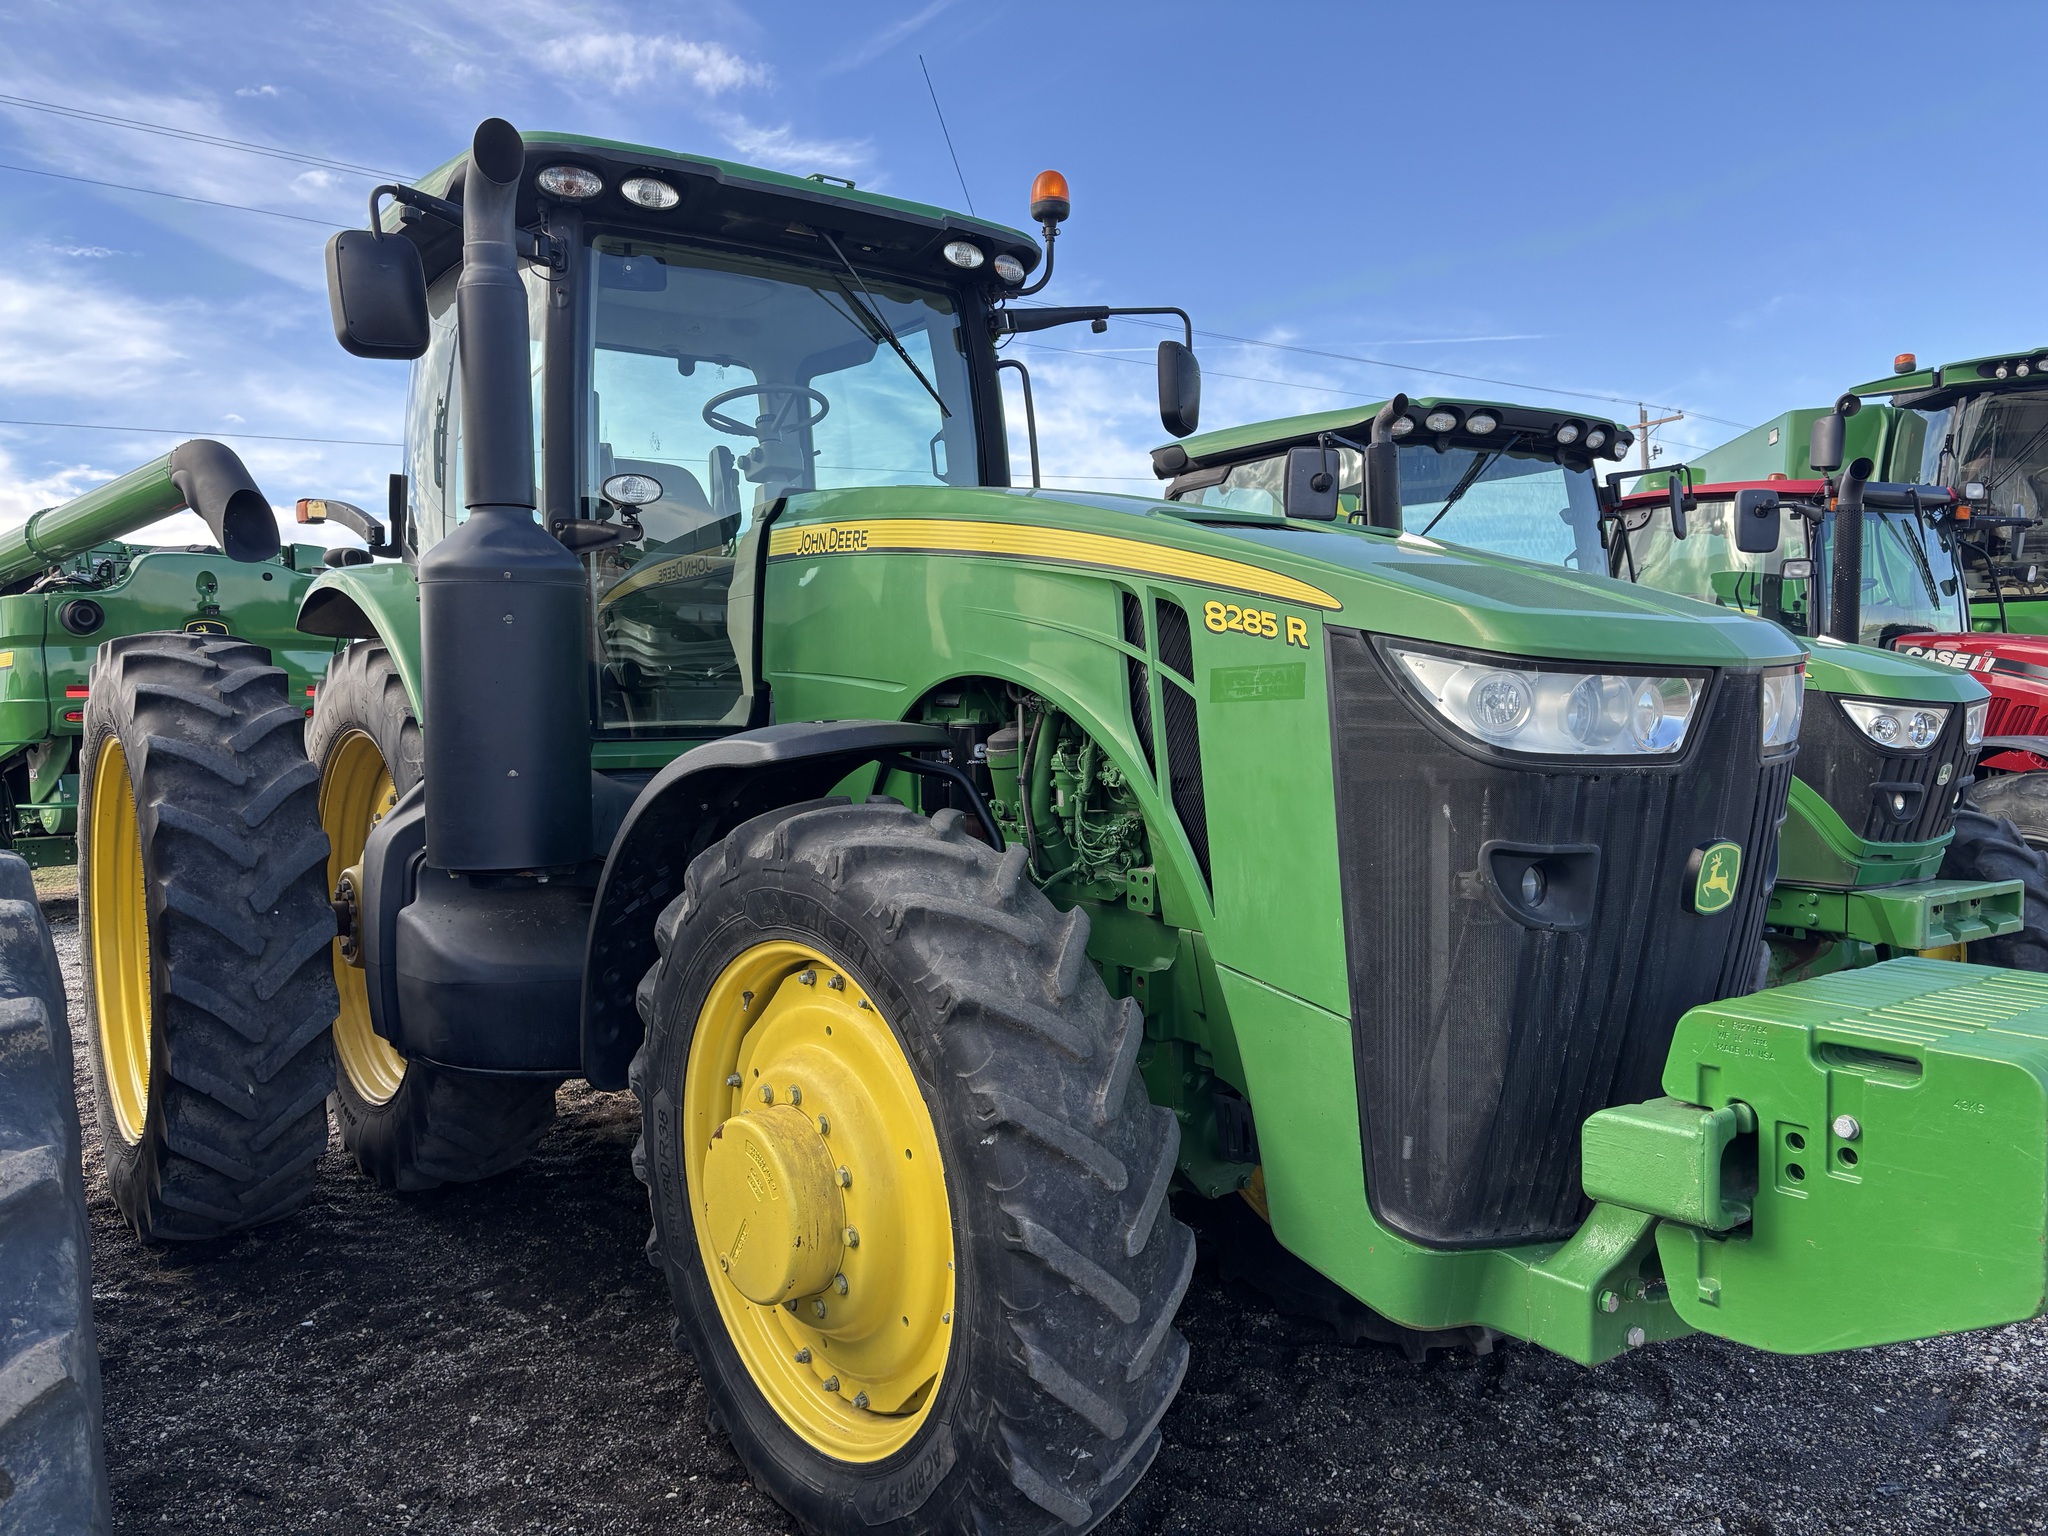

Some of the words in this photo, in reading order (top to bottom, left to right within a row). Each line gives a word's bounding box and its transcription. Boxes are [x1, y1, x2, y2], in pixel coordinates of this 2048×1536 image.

[797, 530, 827, 553] JOHN
[828, 527, 869, 550] DEERE
[1203, 600, 1279, 640] 8285
[1285, 614, 1311, 650] R
[1758, 1050, 1776, 1061] USA
